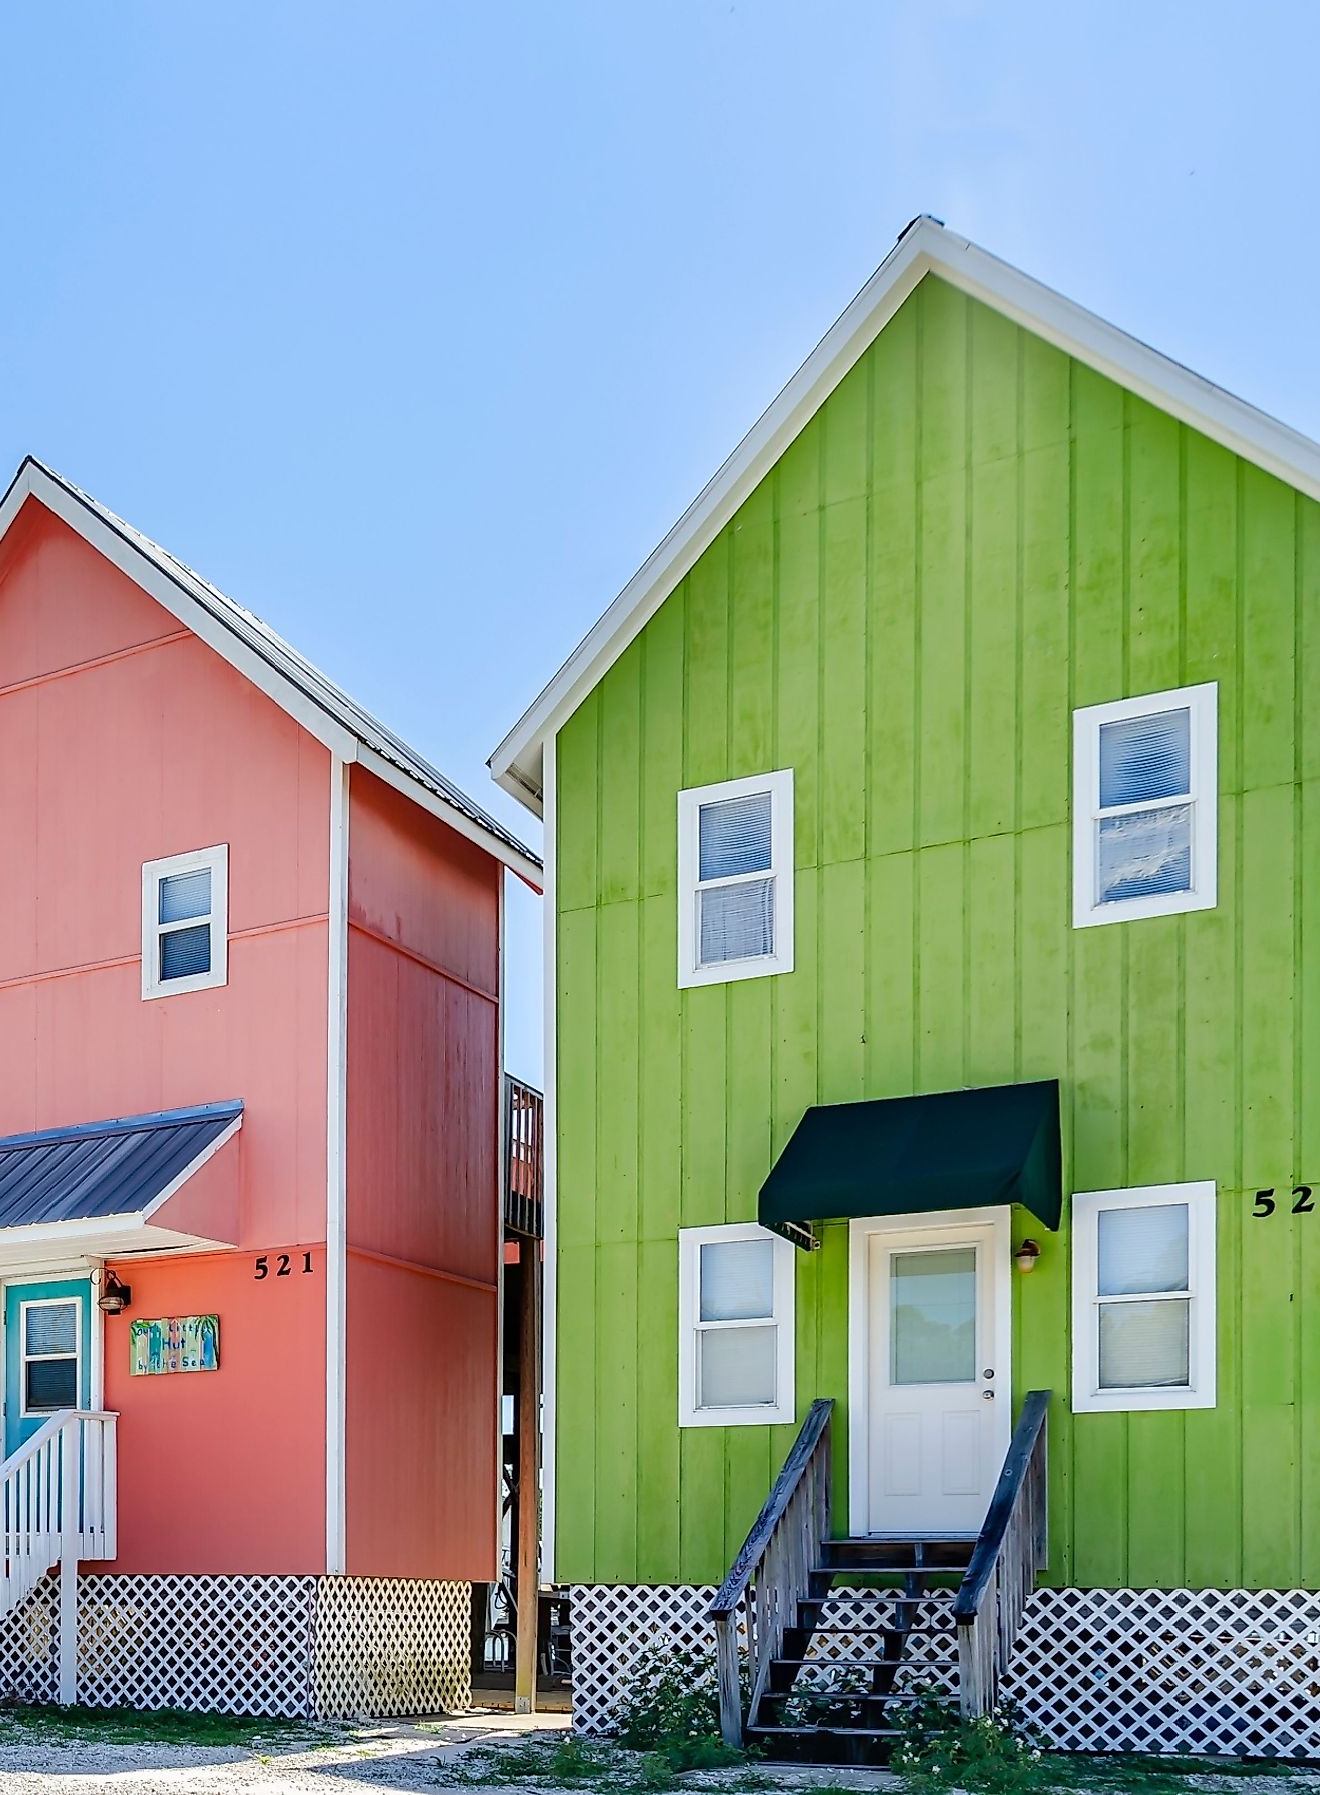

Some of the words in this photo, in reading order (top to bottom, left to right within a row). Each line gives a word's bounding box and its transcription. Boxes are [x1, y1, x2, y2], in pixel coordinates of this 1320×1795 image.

[254, 1251, 314, 1280] 521
[162, 1337, 186, 1350] Hut
[138, 1360, 148, 1373] by
[182, 1357, 206, 1368] Sea
